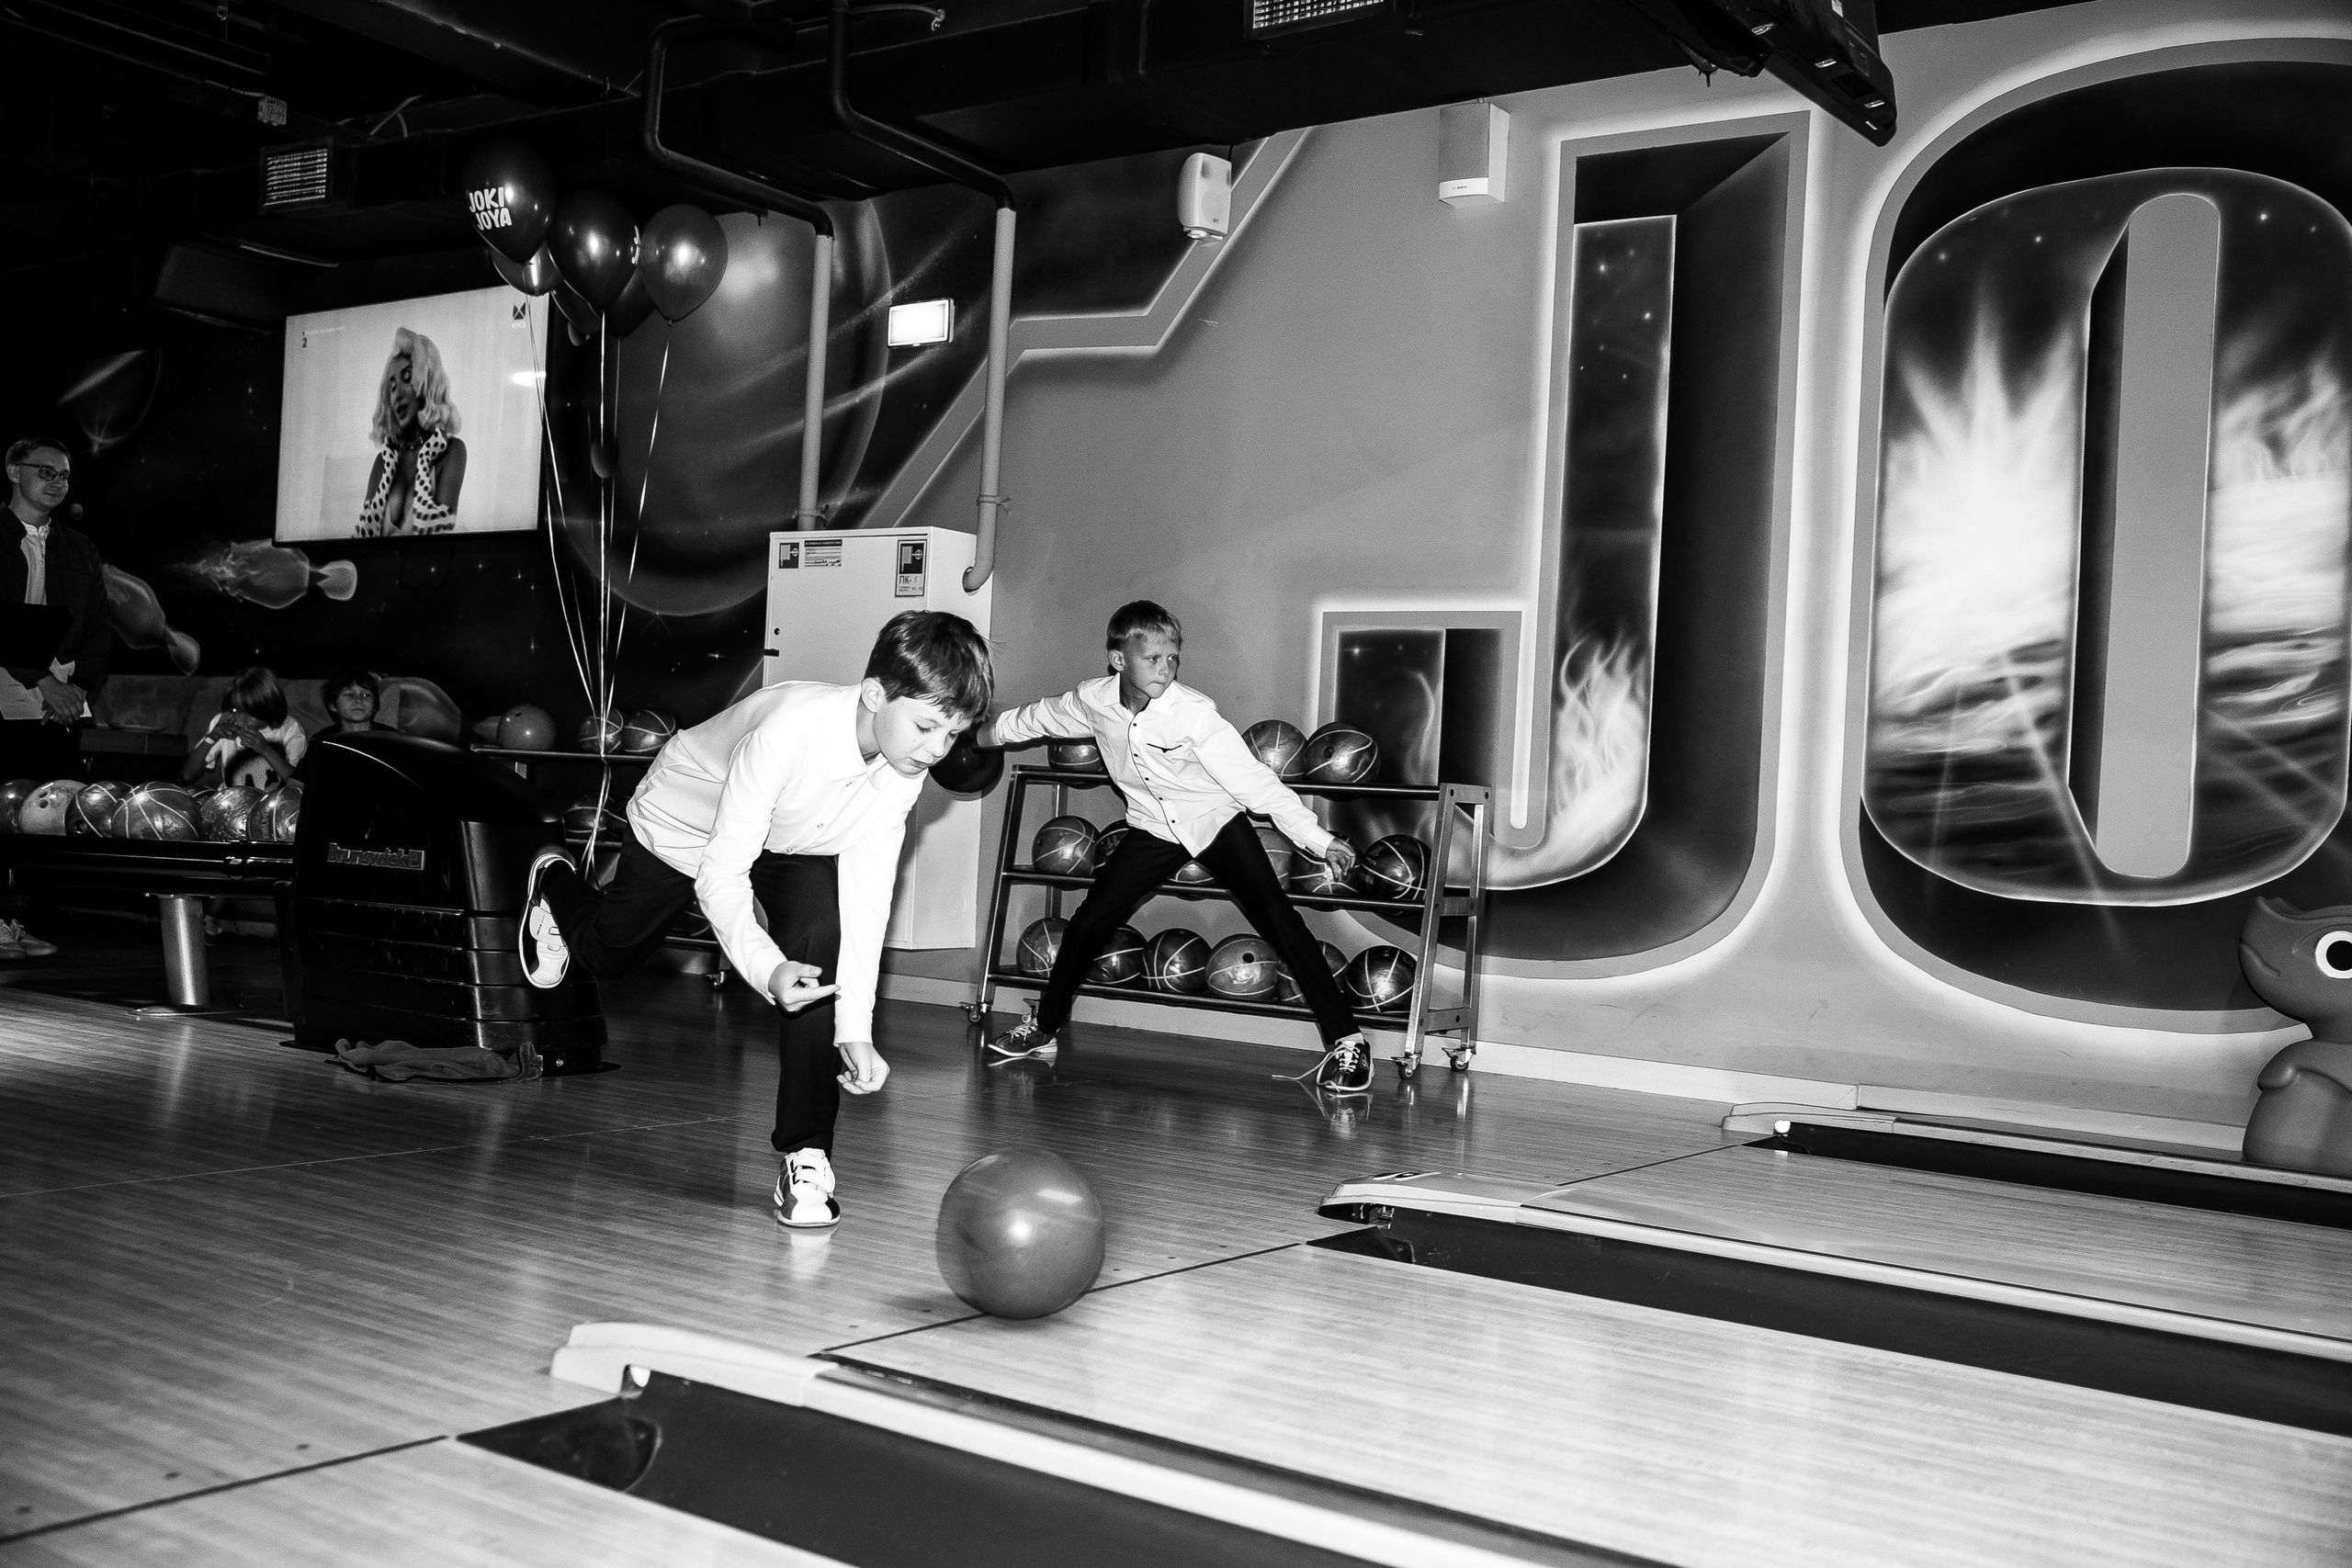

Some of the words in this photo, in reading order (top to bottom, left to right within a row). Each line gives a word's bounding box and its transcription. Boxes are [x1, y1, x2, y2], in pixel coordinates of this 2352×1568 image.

[469, 186, 505, 213] JOKI
[475, 207, 513, 231] JOYA
[326, 841, 410, 870] Brunswick
